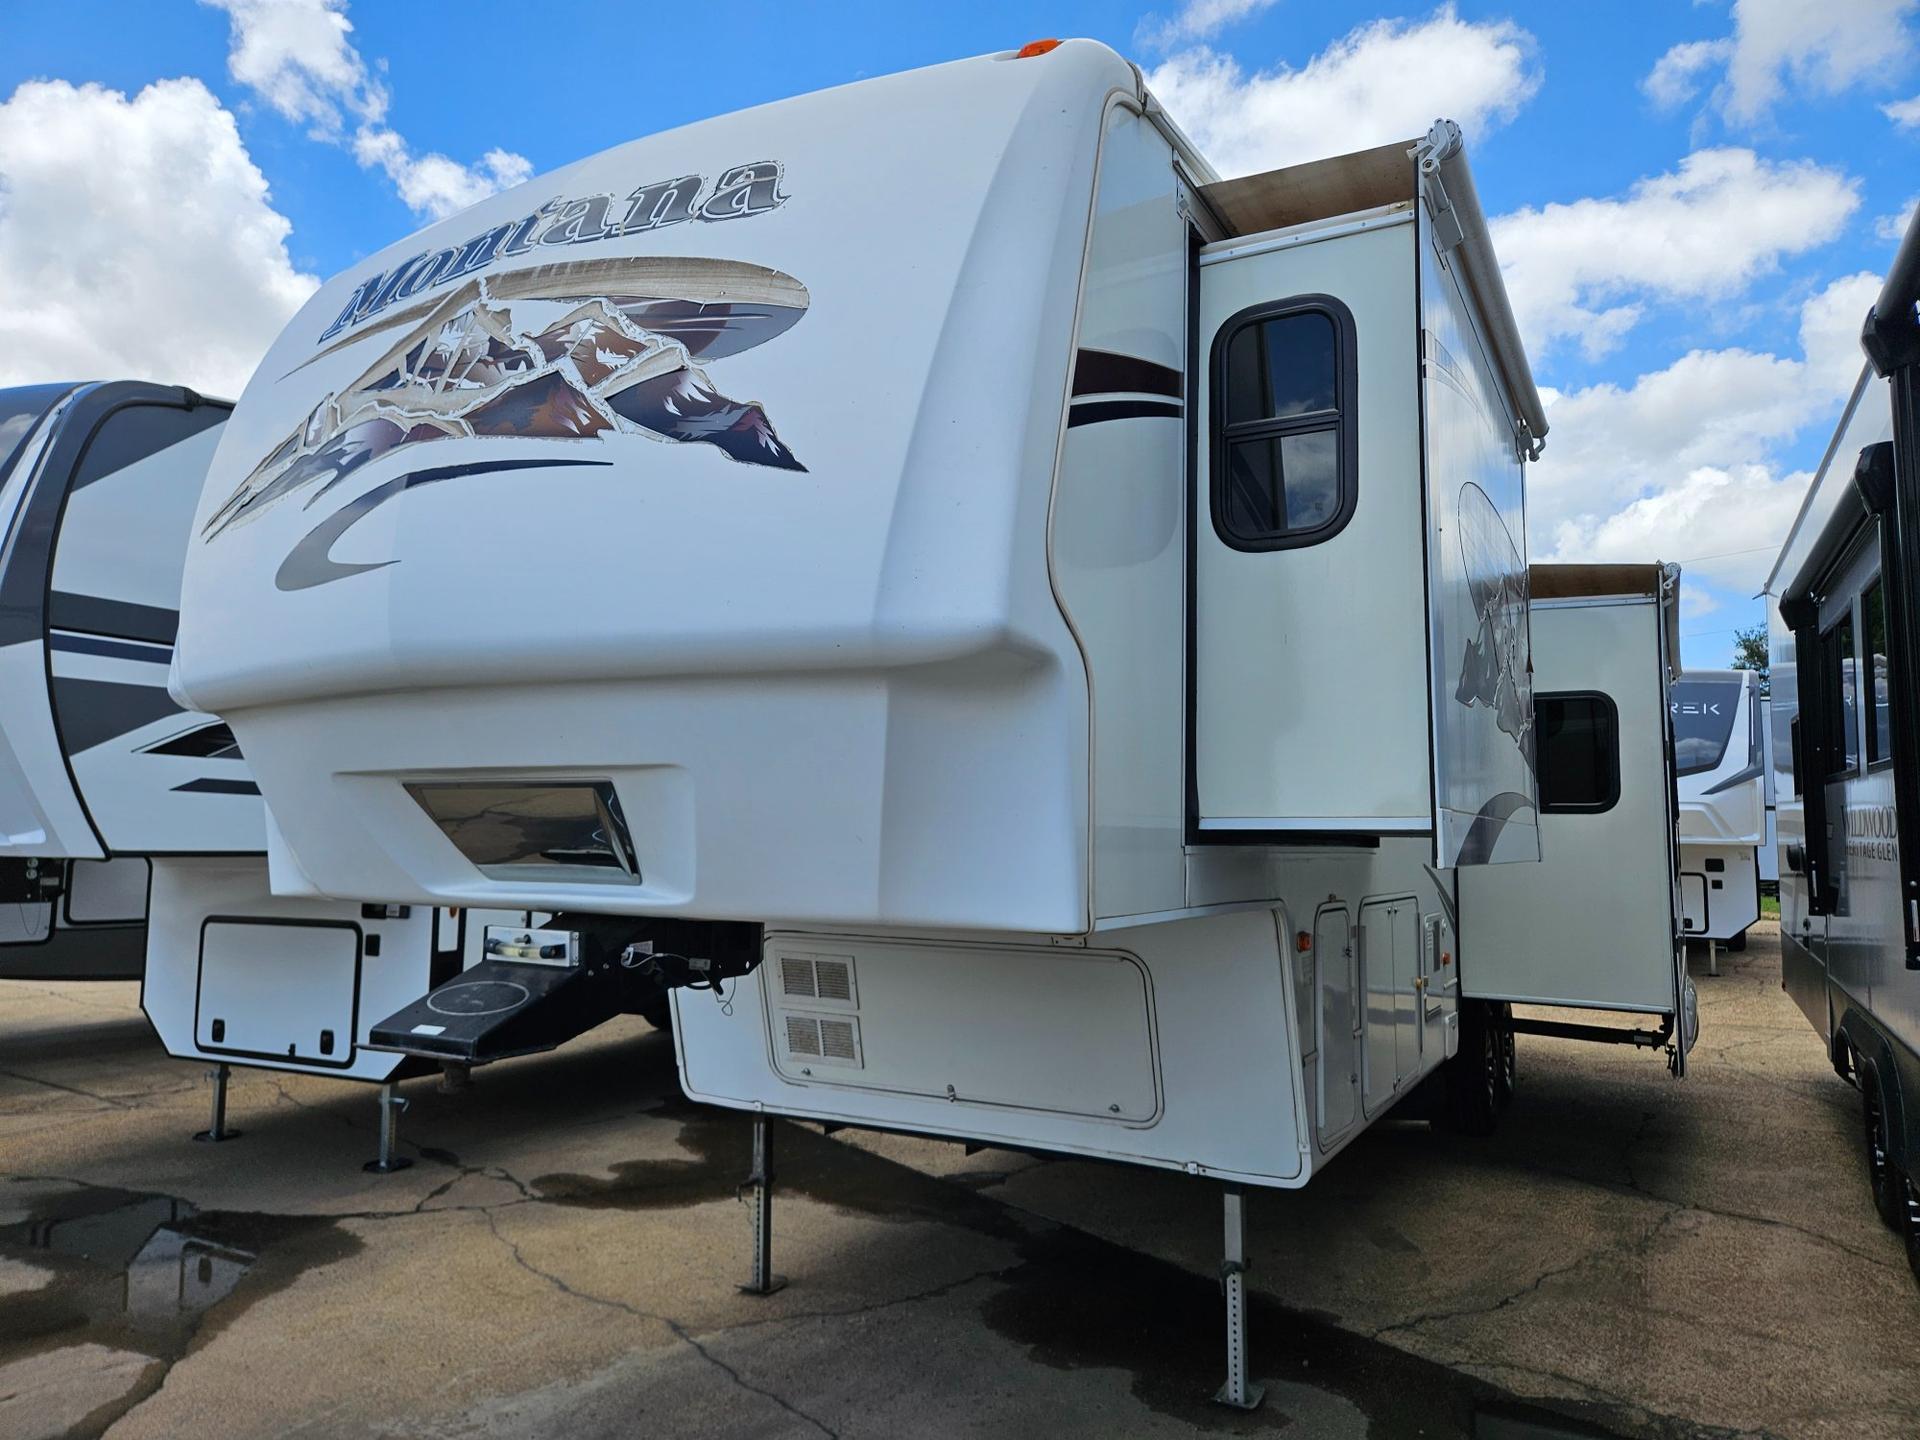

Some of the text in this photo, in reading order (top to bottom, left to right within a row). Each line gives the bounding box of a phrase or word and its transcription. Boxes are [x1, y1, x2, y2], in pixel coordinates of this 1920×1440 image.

[318, 160, 791, 344] Montana
[1840, 805, 1898, 839] WILDWOOD
[1877, 842, 1898, 862] GLEN
